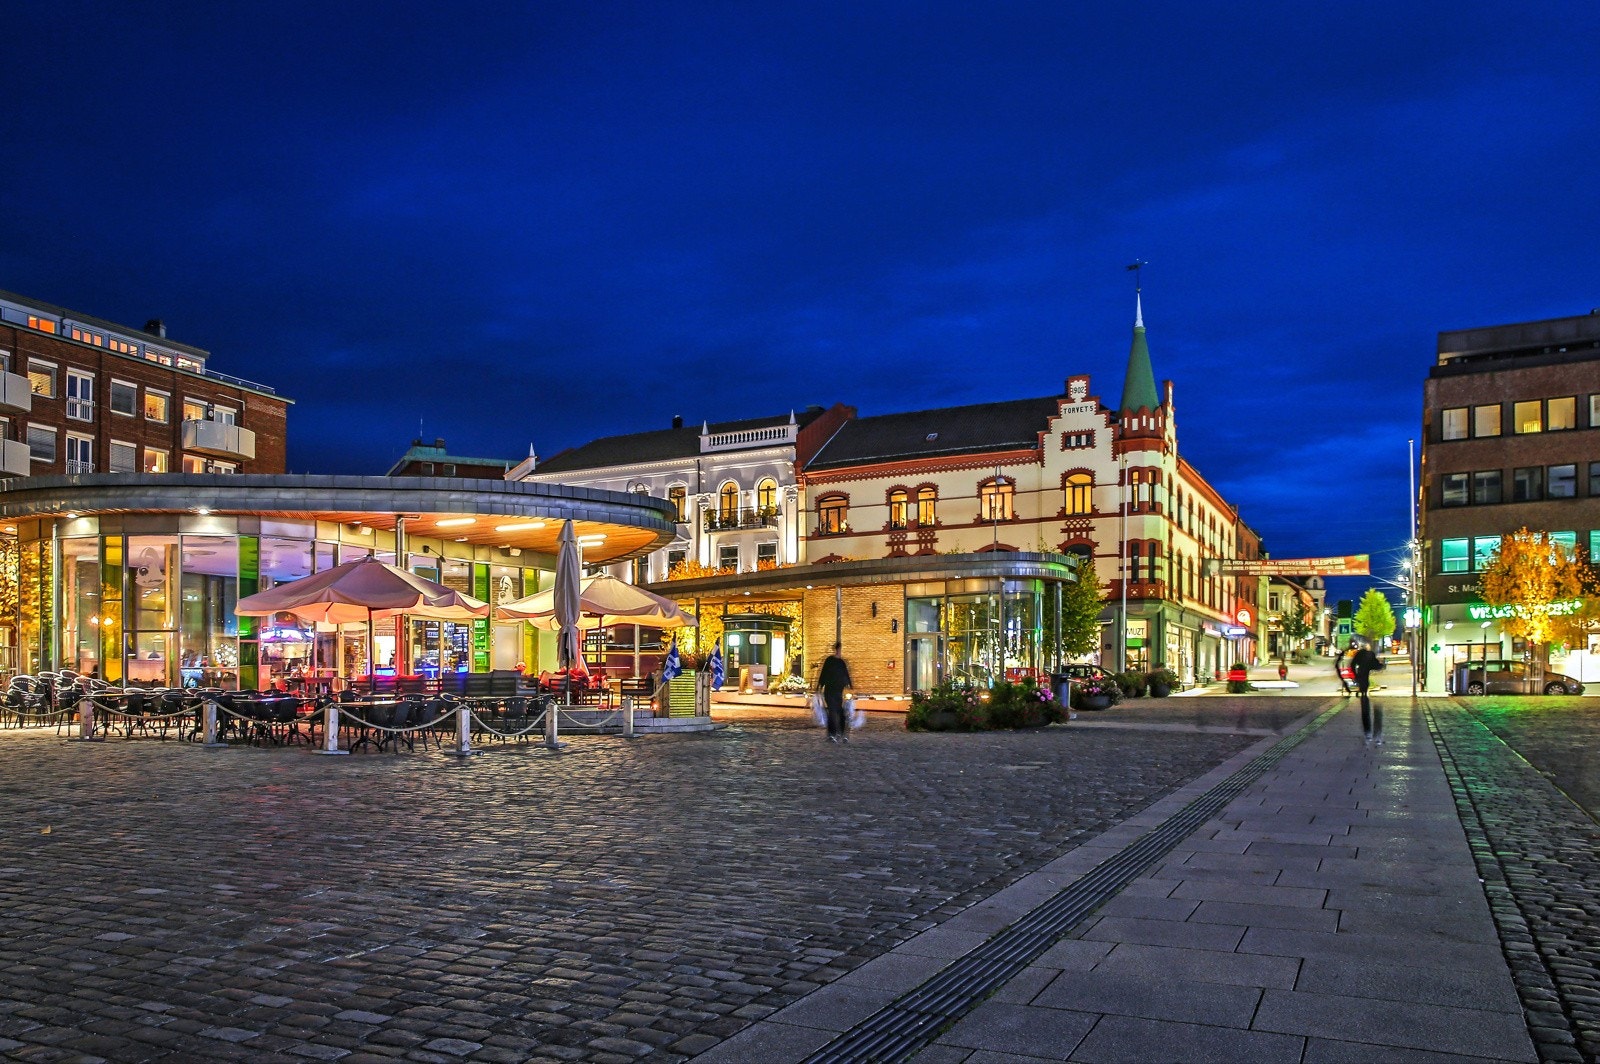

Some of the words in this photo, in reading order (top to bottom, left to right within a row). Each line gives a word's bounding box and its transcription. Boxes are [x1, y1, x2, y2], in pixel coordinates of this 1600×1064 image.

[1072, 386, 1085, 394] 1902
[1063, 405, 1094, 414] TORVETS
[1448, 585, 1460, 593] St.
